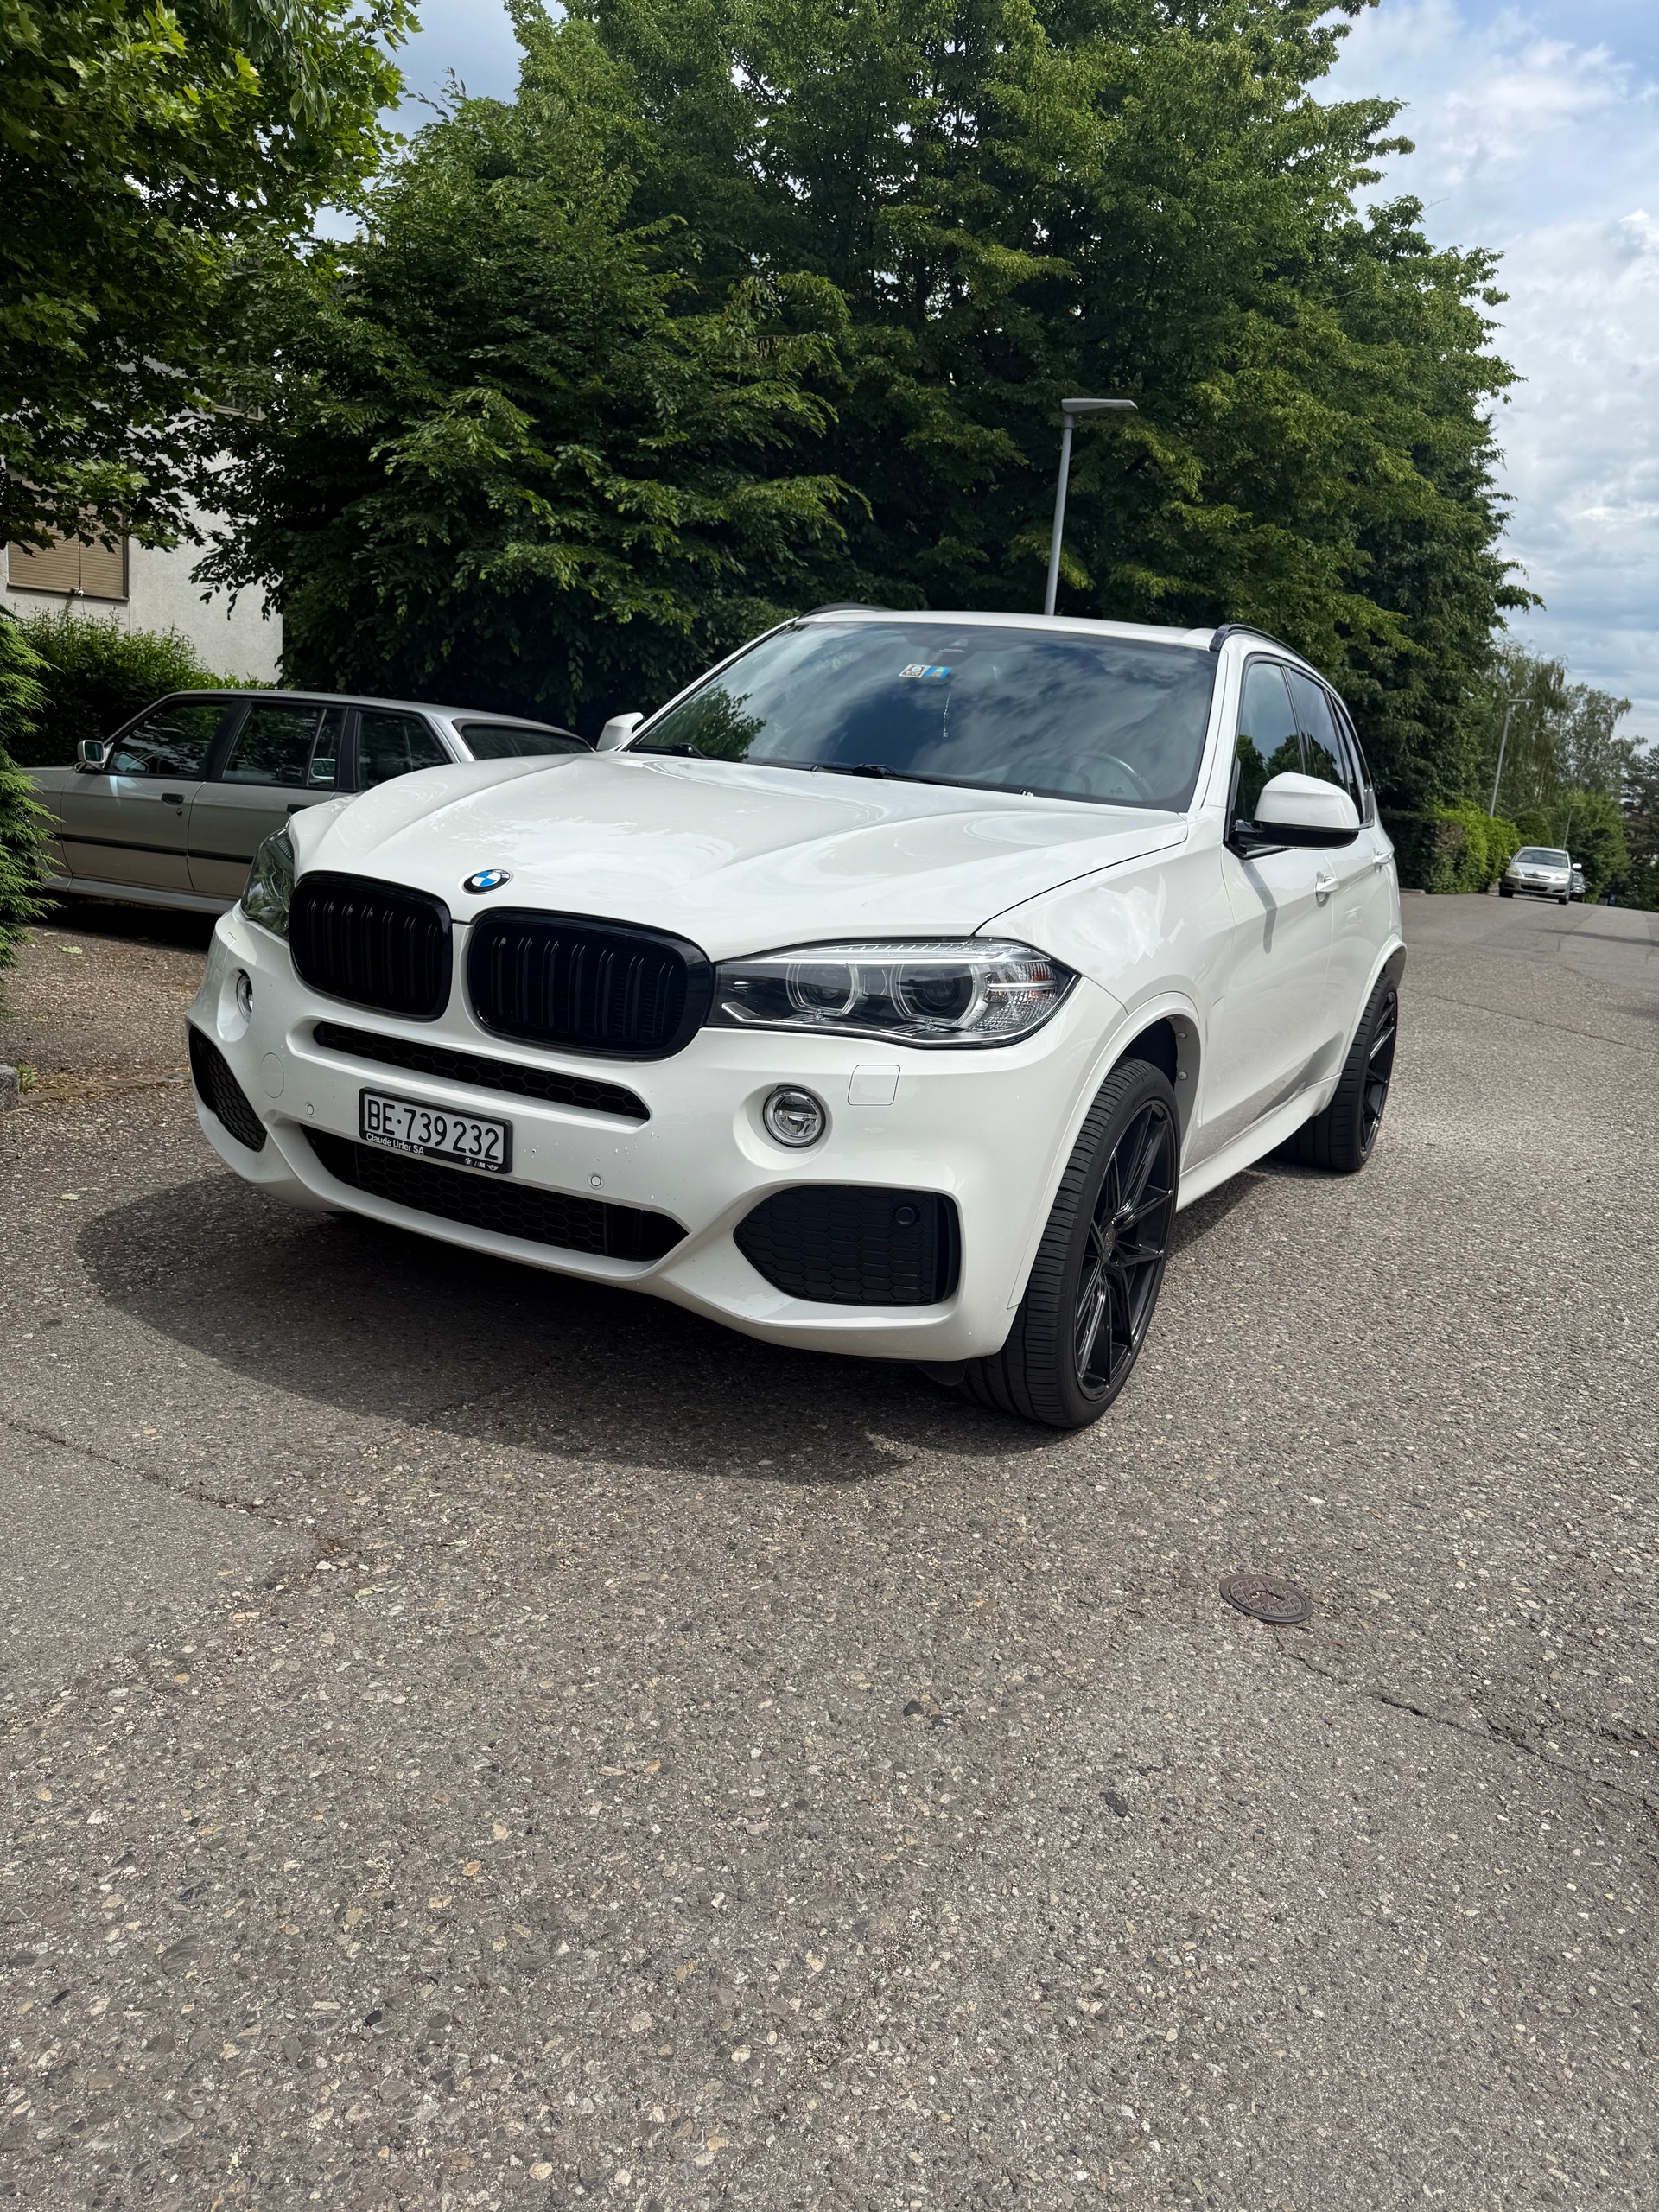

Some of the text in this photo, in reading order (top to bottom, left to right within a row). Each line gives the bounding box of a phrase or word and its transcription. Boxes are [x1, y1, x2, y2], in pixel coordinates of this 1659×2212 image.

[366, 1133, 425, 1156] Claude Urfer SA
